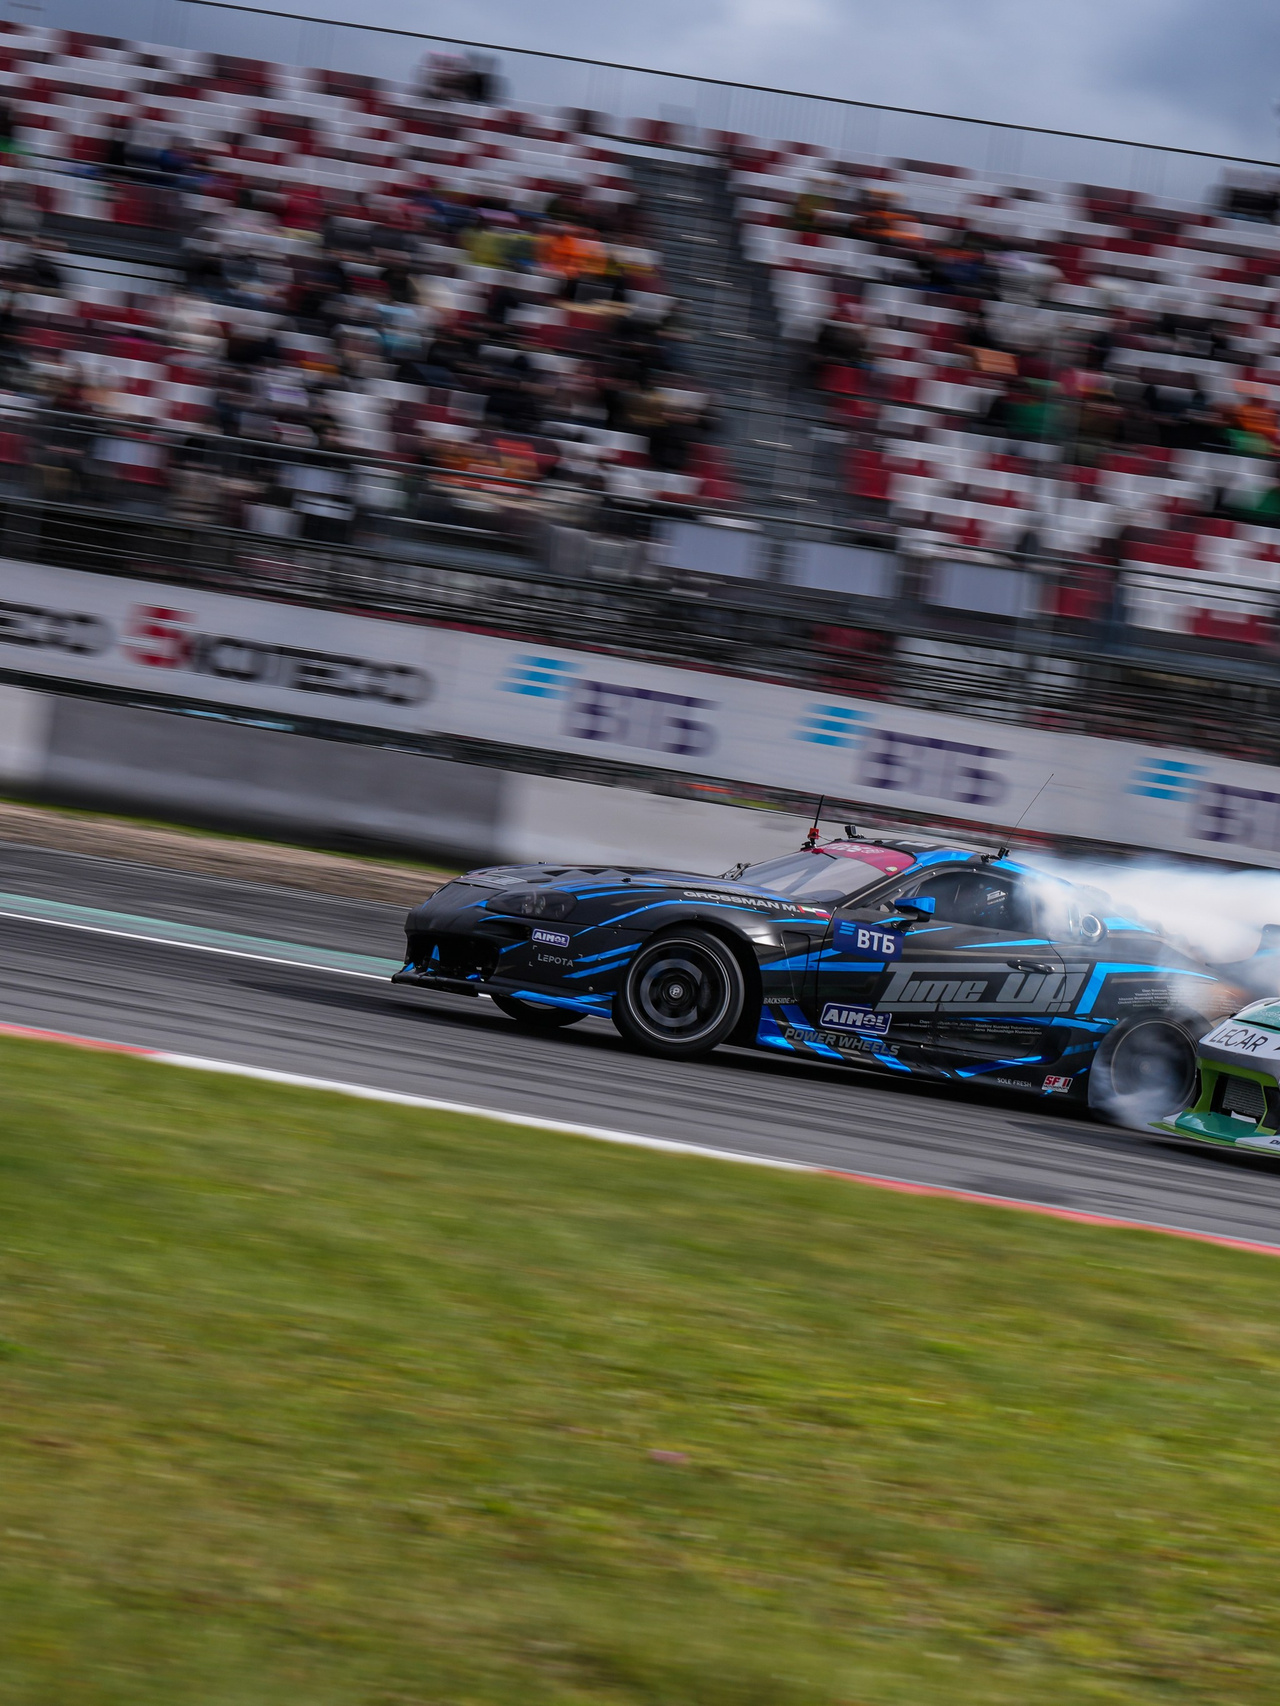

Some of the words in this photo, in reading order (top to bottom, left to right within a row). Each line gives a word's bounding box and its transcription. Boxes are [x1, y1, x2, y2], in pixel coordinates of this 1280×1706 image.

[560, 680, 724, 757] ВТБ
[855, 728, 1016, 806] ВТБ
[683, 891, 779, 910] GROSSMAN
[533, 931, 568, 945] AIMOL
[857, 929, 895, 954] ВТБ
[537, 953, 574, 967] LEPOTA
[824, 1009, 886, 1029] AIMOL
[785, 1028, 835, 1045] POWER
[838, 1035, 899, 1056] WHEELS
[1209, 1027, 1269, 1052] LECAR
[1013, 1080, 1032, 1088] FRESH
